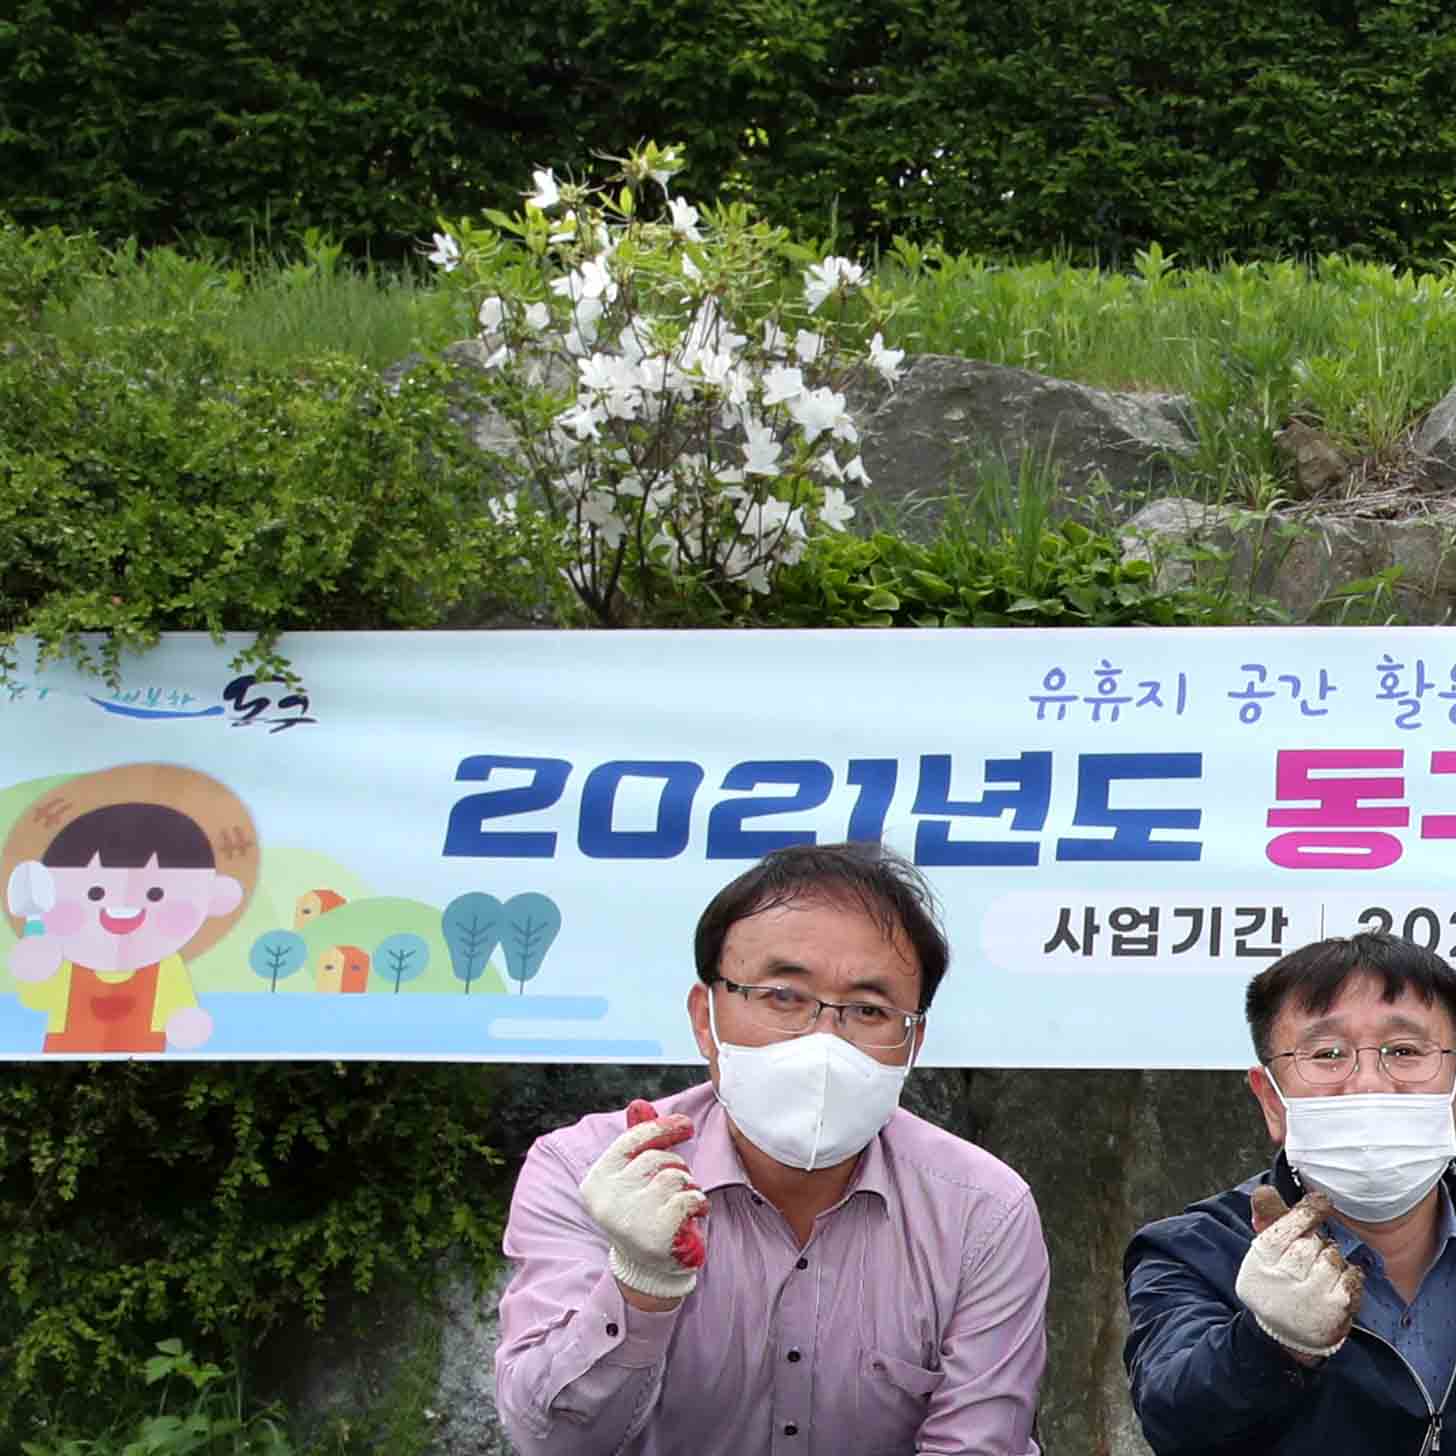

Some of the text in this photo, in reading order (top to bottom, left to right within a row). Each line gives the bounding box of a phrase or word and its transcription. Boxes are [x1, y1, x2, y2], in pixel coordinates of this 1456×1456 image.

[1028, 658, 1188, 722] 유휴지
[1227, 662, 1337, 725] 공간
[441, 750, 1203, 867] 2021년도
[1043, 906, 1288, 958] 사업기간
